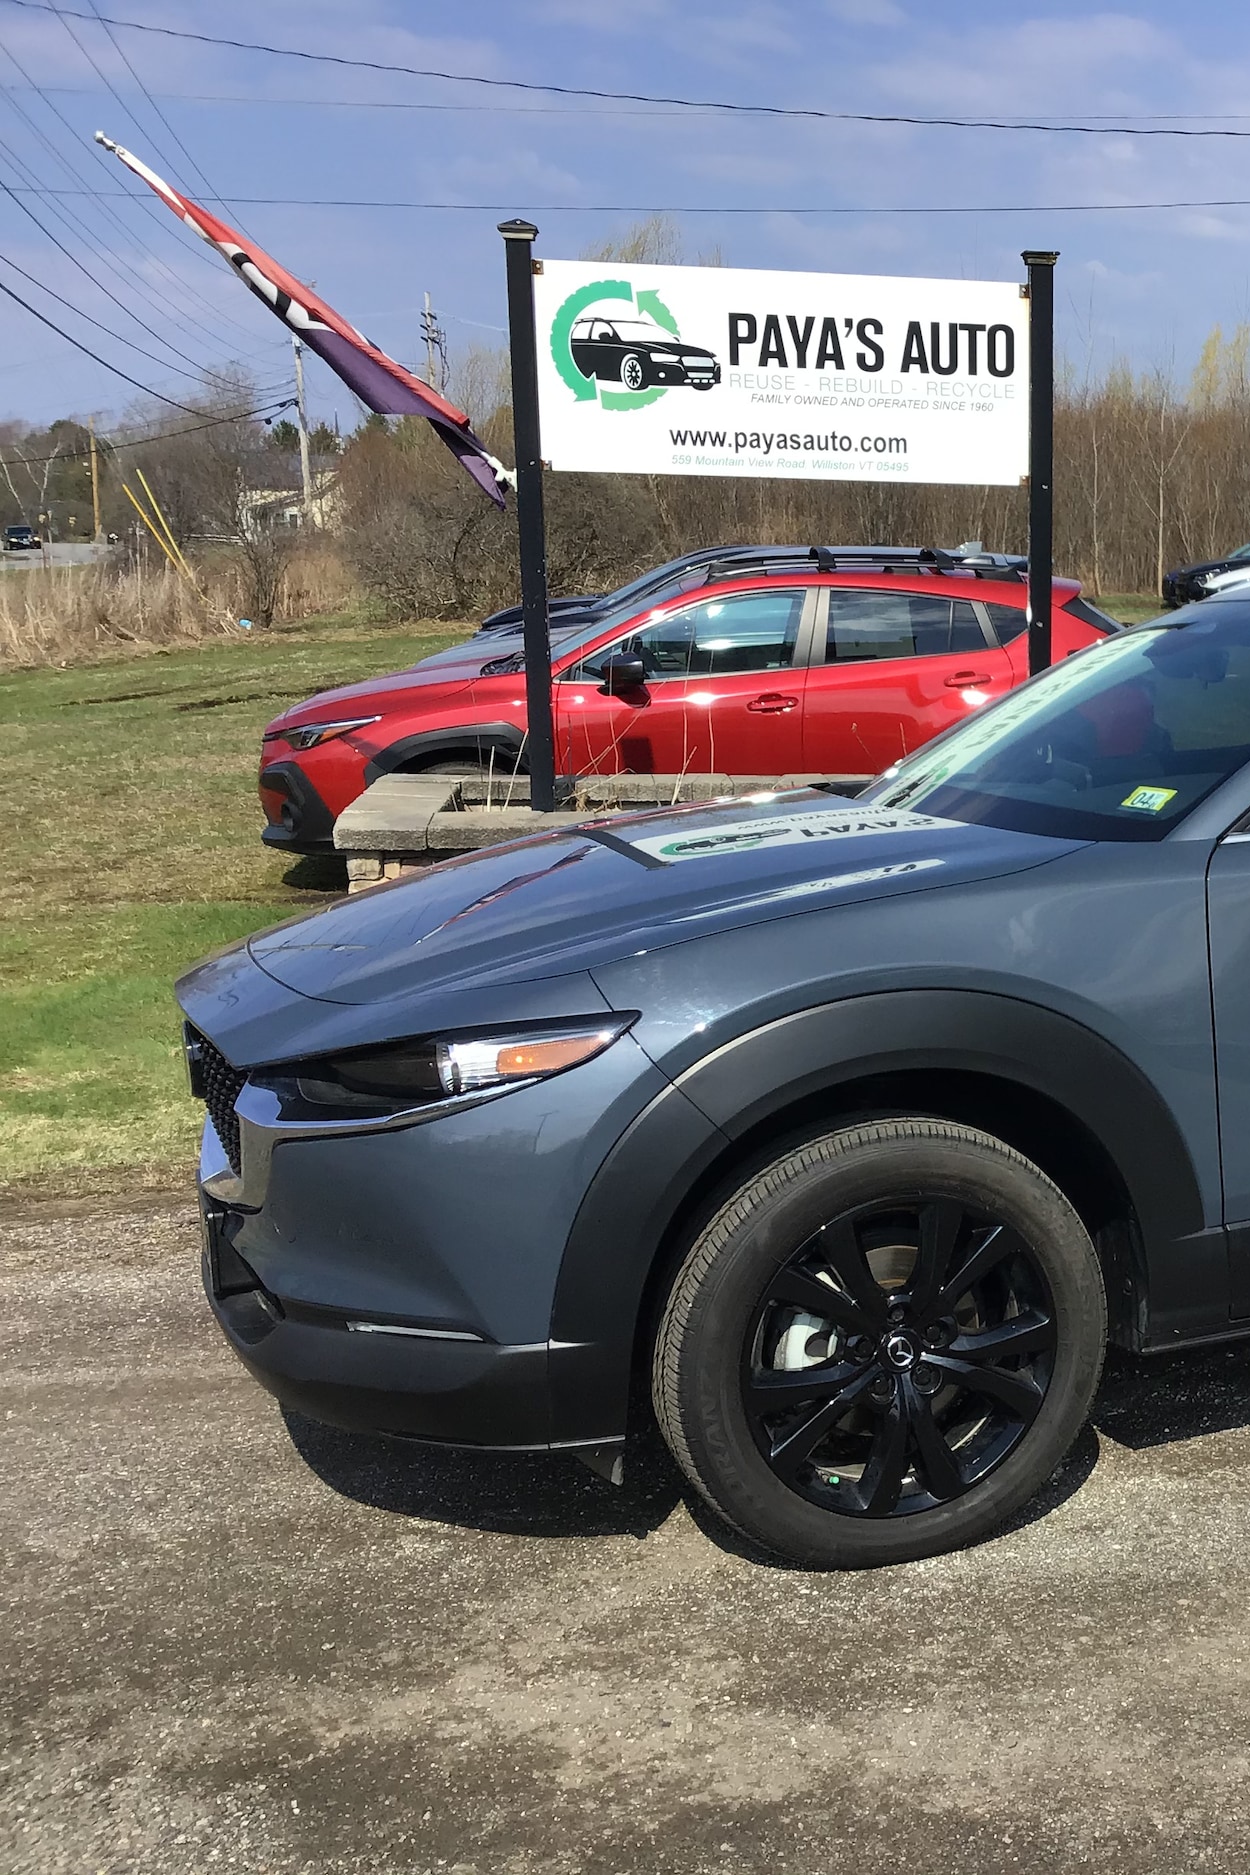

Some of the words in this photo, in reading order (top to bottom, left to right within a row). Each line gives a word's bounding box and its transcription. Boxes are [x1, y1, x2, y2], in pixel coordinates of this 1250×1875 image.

[728, 312, 885, 373] PAYA'S
[900, 321, 1015, 378] AUTO
[729, 373, 796, 390] REUSE
[819, 377, 903, 394] REBUILD
[926, 381, 1015, 399] RECYCLE
[750, 393, 791, 405] FAMILY
[794, 395, 838, 407] OWNED
[840, 397, 866, 407] AND
[867, 398, 929, 410] OPERATED
[932, 400, 966, 411] SINCE
[970, 402, 994, 412] 1960
[669, 429, 907, 455] www.payasauto.com
[671, 455, 692, 465] 559
[695, 455, 745, 467] Mountain
[748, 457, 774, 468] View
[811, 459, 855, 471] Williston
[859, 461, 874, 471] VT
[876, 461, 909, 472] 05495
